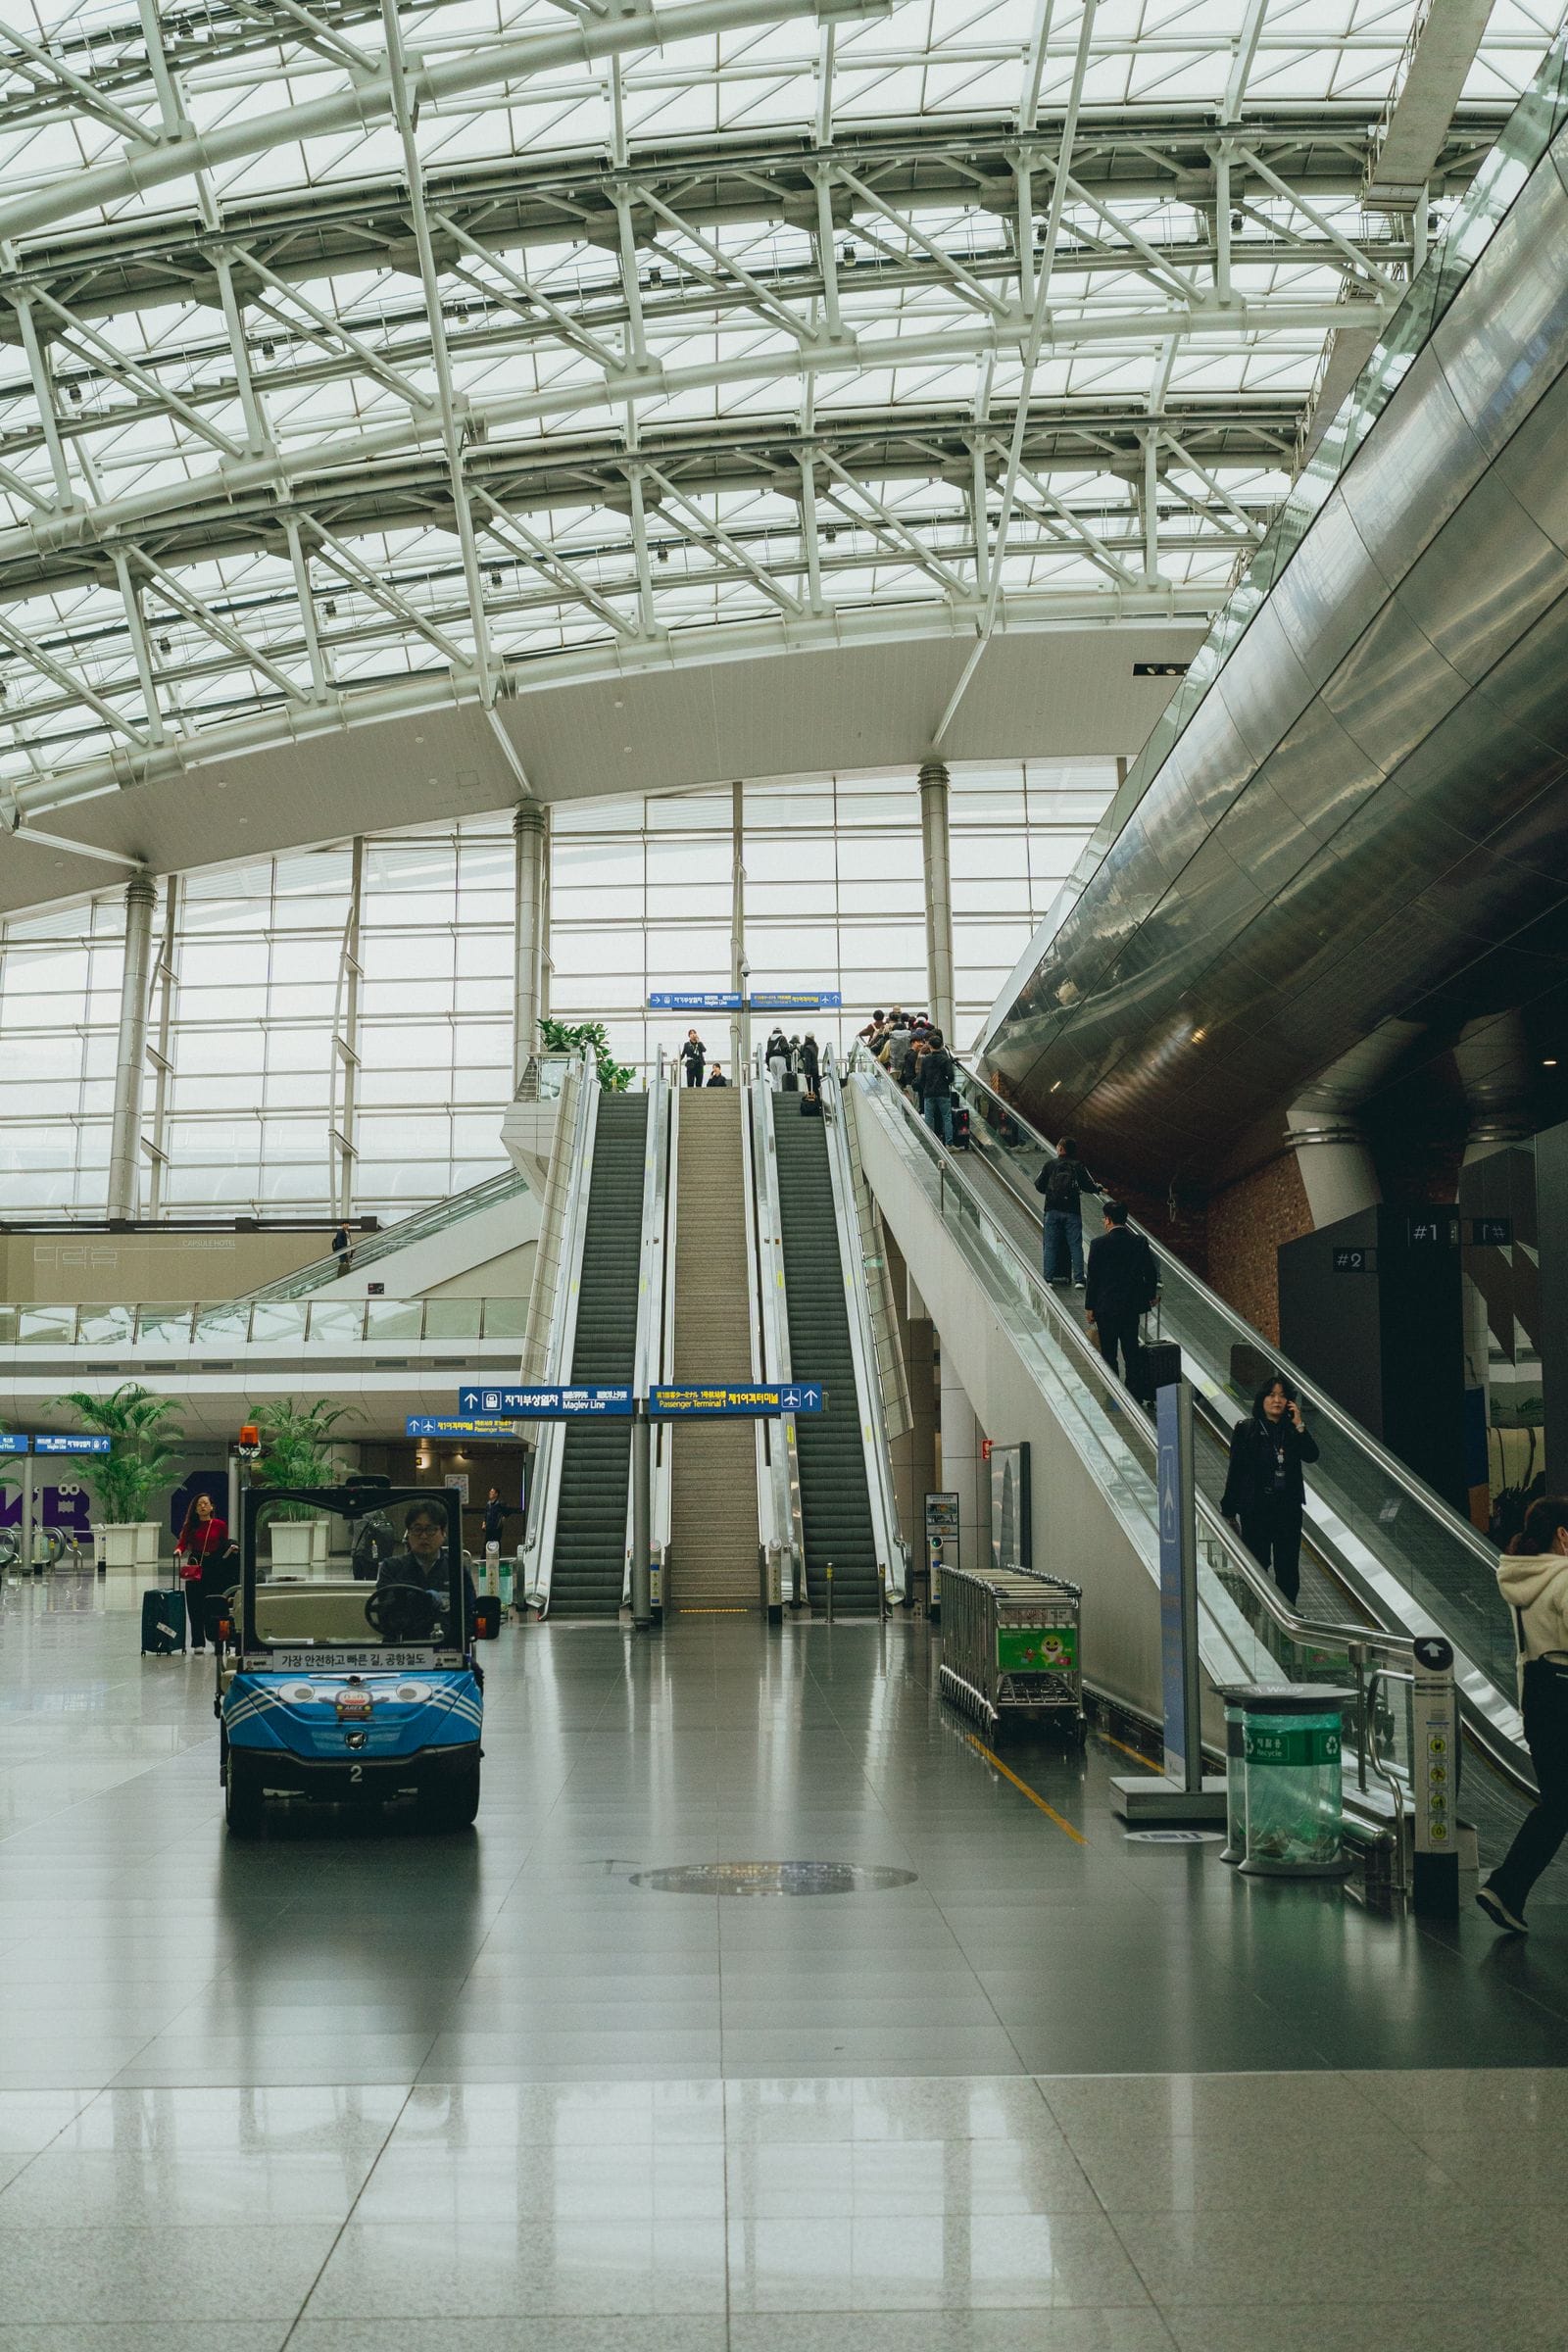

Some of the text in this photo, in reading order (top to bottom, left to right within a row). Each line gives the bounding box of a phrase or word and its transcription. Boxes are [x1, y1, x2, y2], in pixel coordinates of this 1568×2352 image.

[1412, 1223, 1438, 1240] #1
[214, 1238, 235, 1248] HOTEL
[1337, 1252, 1362, 1268] #2
[505, 1395, 560, 1407] 자기부상열차
[728, 1393, 779, 1404] 제1여객터미널
[563, 1400, 606, 1411] Maglev Line
[659, 1400, 691, 1410] Passenger
[693, 1399, 721, 1408] Terminal
[281, 1654, 303, 1667] 가장
[304, 1654, 345, 1667] 안전하고
[346, 1653, 368, 1667] 빠른
[369, 1653, 383, 1667] 길,
[384, 1652, 427, 1666] 공항철도
[1256, 1748, 1283, 1758] Recycle
[350, 1765, 363, 1783] 2
